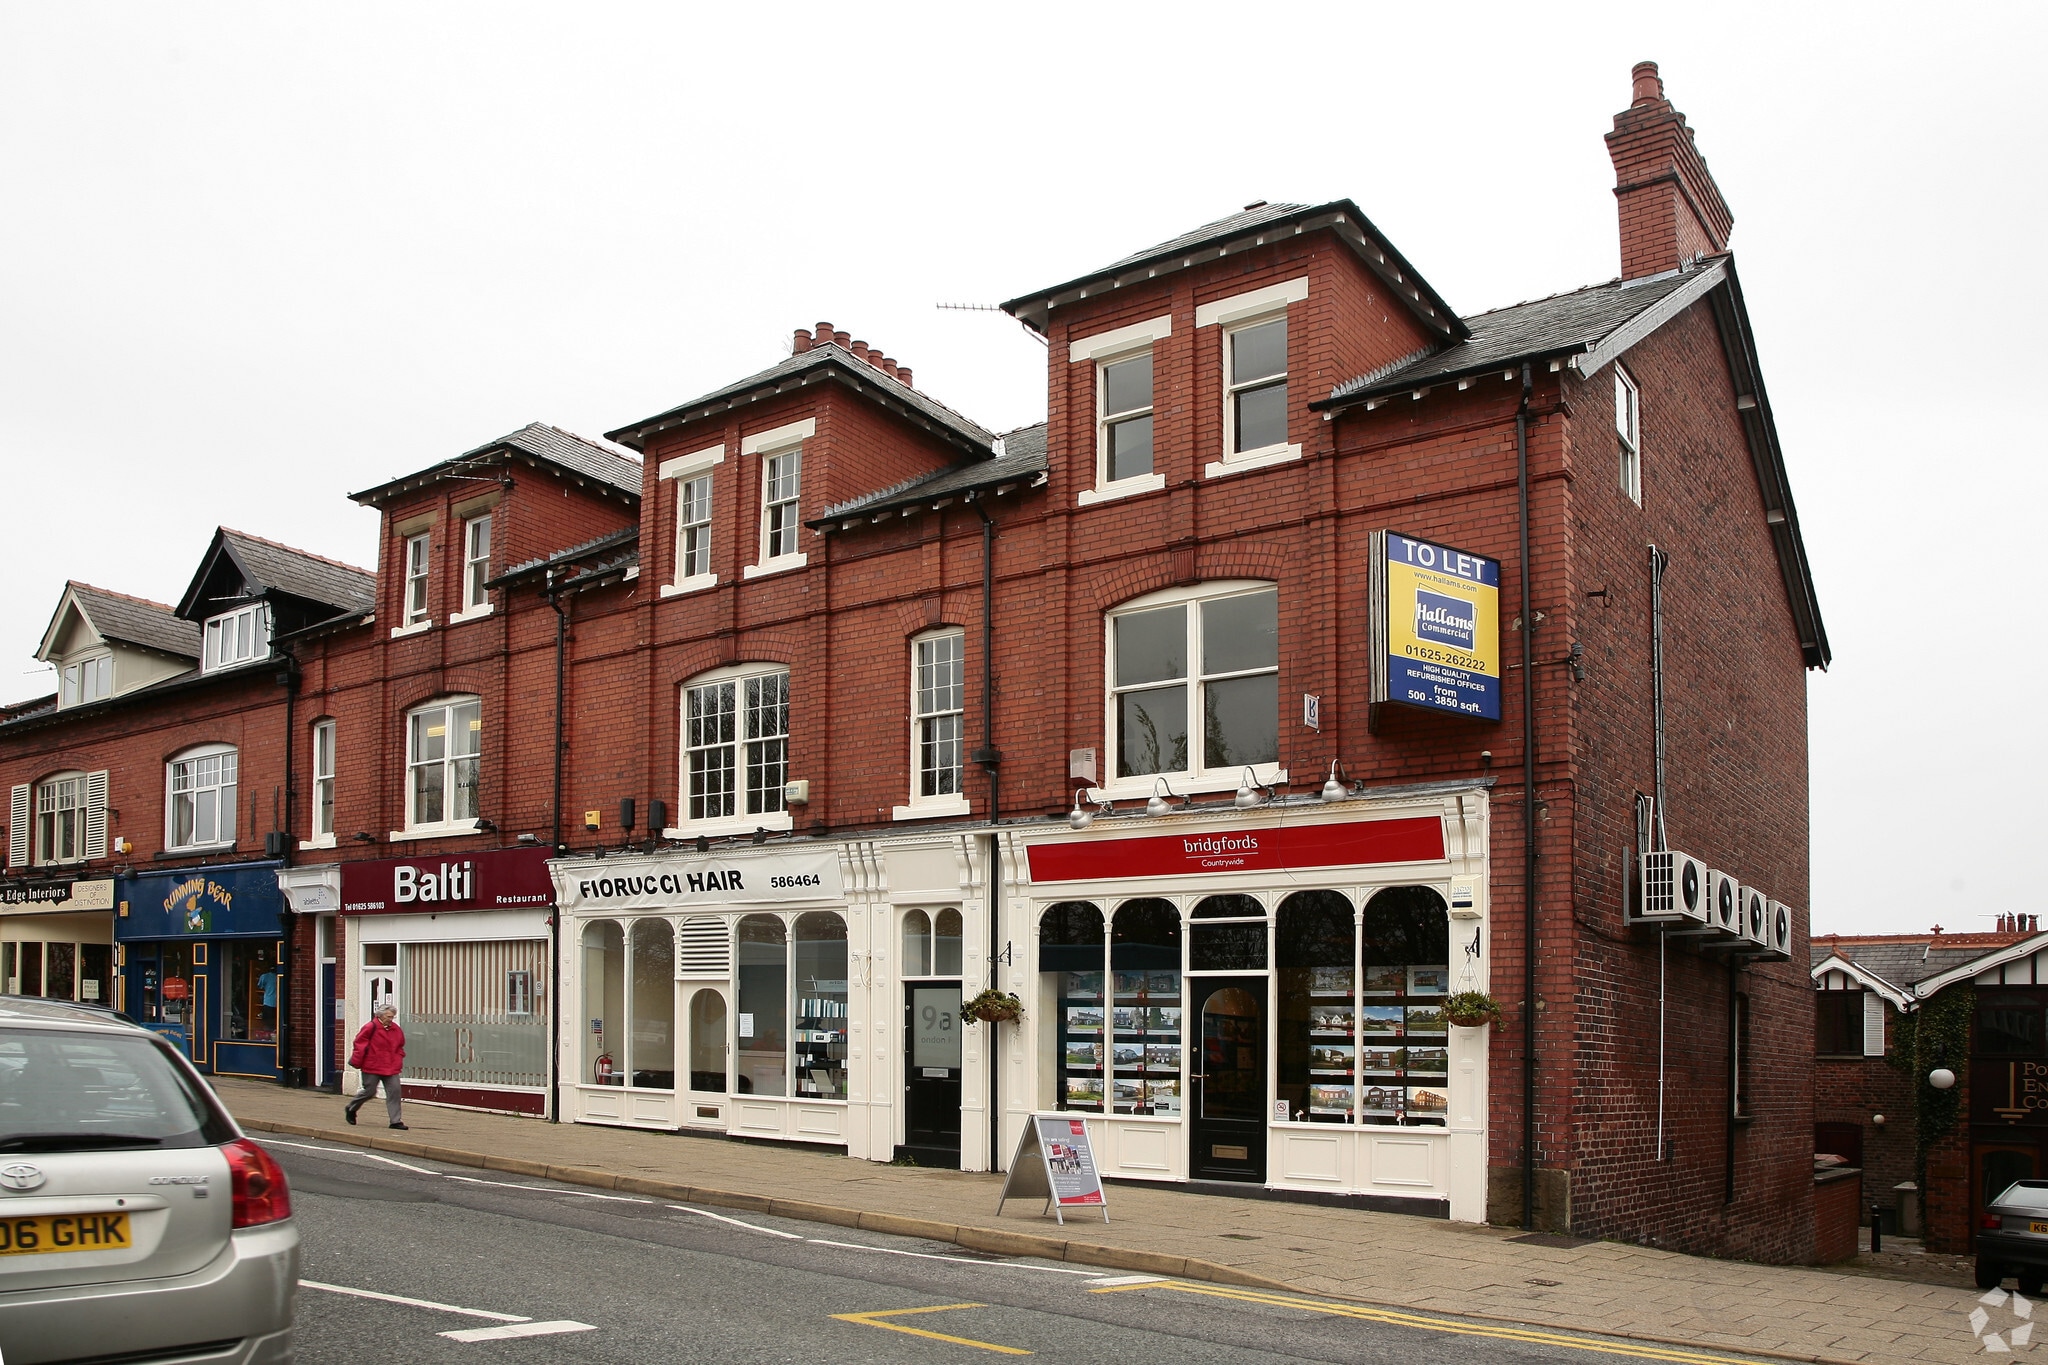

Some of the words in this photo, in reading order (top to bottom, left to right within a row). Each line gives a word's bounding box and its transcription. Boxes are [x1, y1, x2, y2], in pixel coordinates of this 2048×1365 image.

[1402, 539, 1435, 567] TO
[1443, 550, 1486, 580] LET
[1414, 571, 1477, 592] www.hallams.com
[1417, 602, 1473, 631] Hallams
[1421, 622, 1469, 640] Commercial
[1405, 644, 1486, 671] 01625-262222
[1407, 669, 1456, 686] REFURBISHED
[1457, 680, 1486, 692] OFFICES
[1423, 664, 1440, 674] HIGH
[1441, 669, 1471, 680] QUALITY
[1434, 685, 1457, 697] from
[1408, 690, 1426, 701] 500
[1435, 696, 1458, 708] 3850
[1460, 702, 1482, 713] sqft.
[1183, 834, 1258, 854] bridgfords
[1201, 857, 1245, 867] Countrywide
[77, 884, 108, 893] DESIGNERS
[394, 861, 471, 903] Balti
[579, 873, 683, 899] FIORUCCI
[686, 869, 745, 894] HAIR
[770, 873, 821, 889] 586464
[6, 889, 27, 902] Edge
[28, 886, 66, 900] Interiors
[74, 898, 110, 907] DISTINCTION
[163, 877, 206, 915] RUNNING
[207, 880, 233, 912] BEAR
[496, 893, 547, 904] Restaurant
[344, 903, 352, 911] Tel
[922, 1005, 951, 1031] 9a
[52, 1215, 125, 1247] GHK
